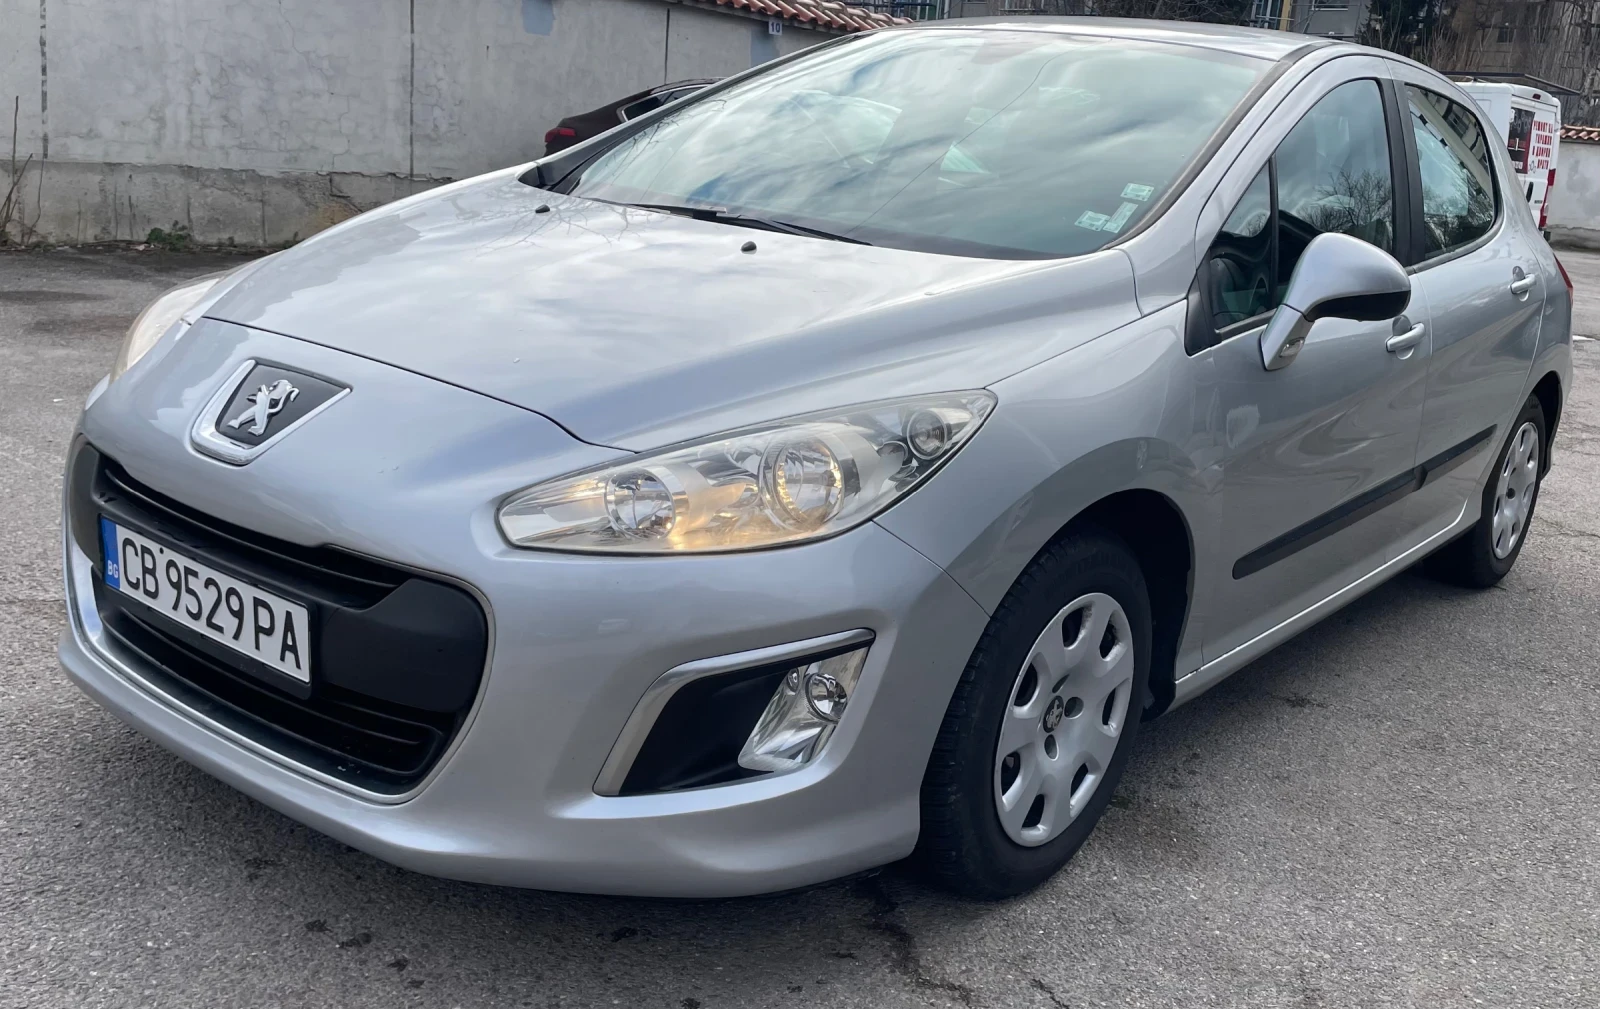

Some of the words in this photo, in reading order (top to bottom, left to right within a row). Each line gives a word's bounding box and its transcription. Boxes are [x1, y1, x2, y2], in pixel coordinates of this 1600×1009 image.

[771, 22, 780, 33] 10
[107, 560, 119, 579] BG
[122, 537, 160, 600] CB
[165, 559, 245, 641] 9529
[252, 596, 302, 670] PA
